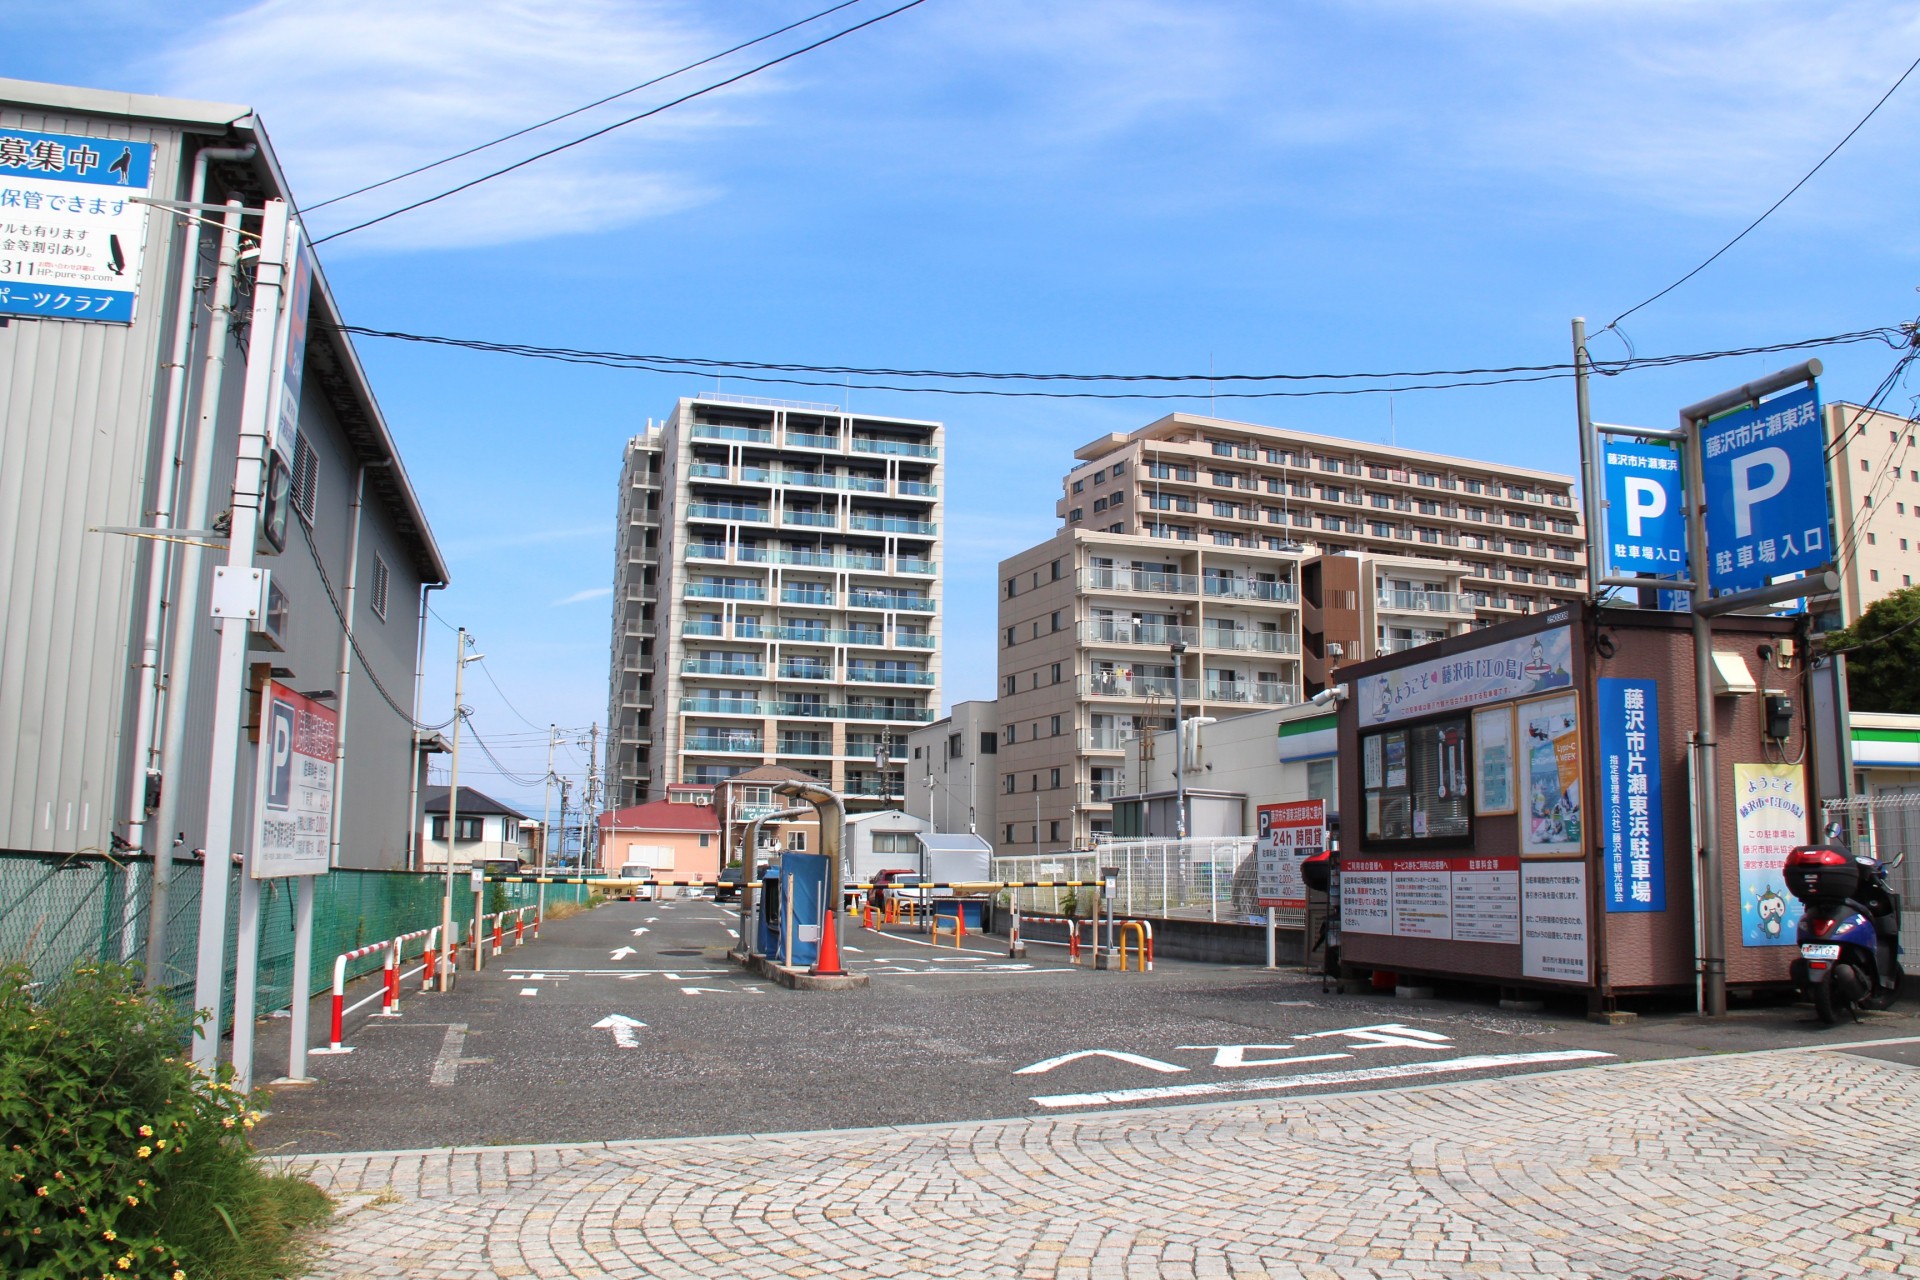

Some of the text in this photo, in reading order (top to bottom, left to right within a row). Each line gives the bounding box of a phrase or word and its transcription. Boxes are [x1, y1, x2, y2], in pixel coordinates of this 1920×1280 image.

[0, 136, 99, 175] 募集中
[1, 188, 129, 216] 保管できます
[0, 223, 90, 240] ルも有ります
[0, 239, 92, 257] 金等割引あり。
[1706, 400, 1815, 458] 藤沢市片瀬東浜
[1607, 453, 1678, 471] 藤沢市片瀬東浜
[1625, 476, 1667, 537] P
[1730, 446, 1791, 539] P
[1614, 543, 1680, 562] 駐車場入口
[1716, 528, 1822, 575] 駐車場入口
[1394, 672, 1429, 704] ようこそ
[271, 714, 290, 796] P
[1623, 688, 1651, 902] 藤沢市片瀬東浜駐車場
[1748, 776, 1793, 793] ようこそ
[1273, 830, 1292, 847] 24h
[1748, 830, 1796, 839] この駐車場は
